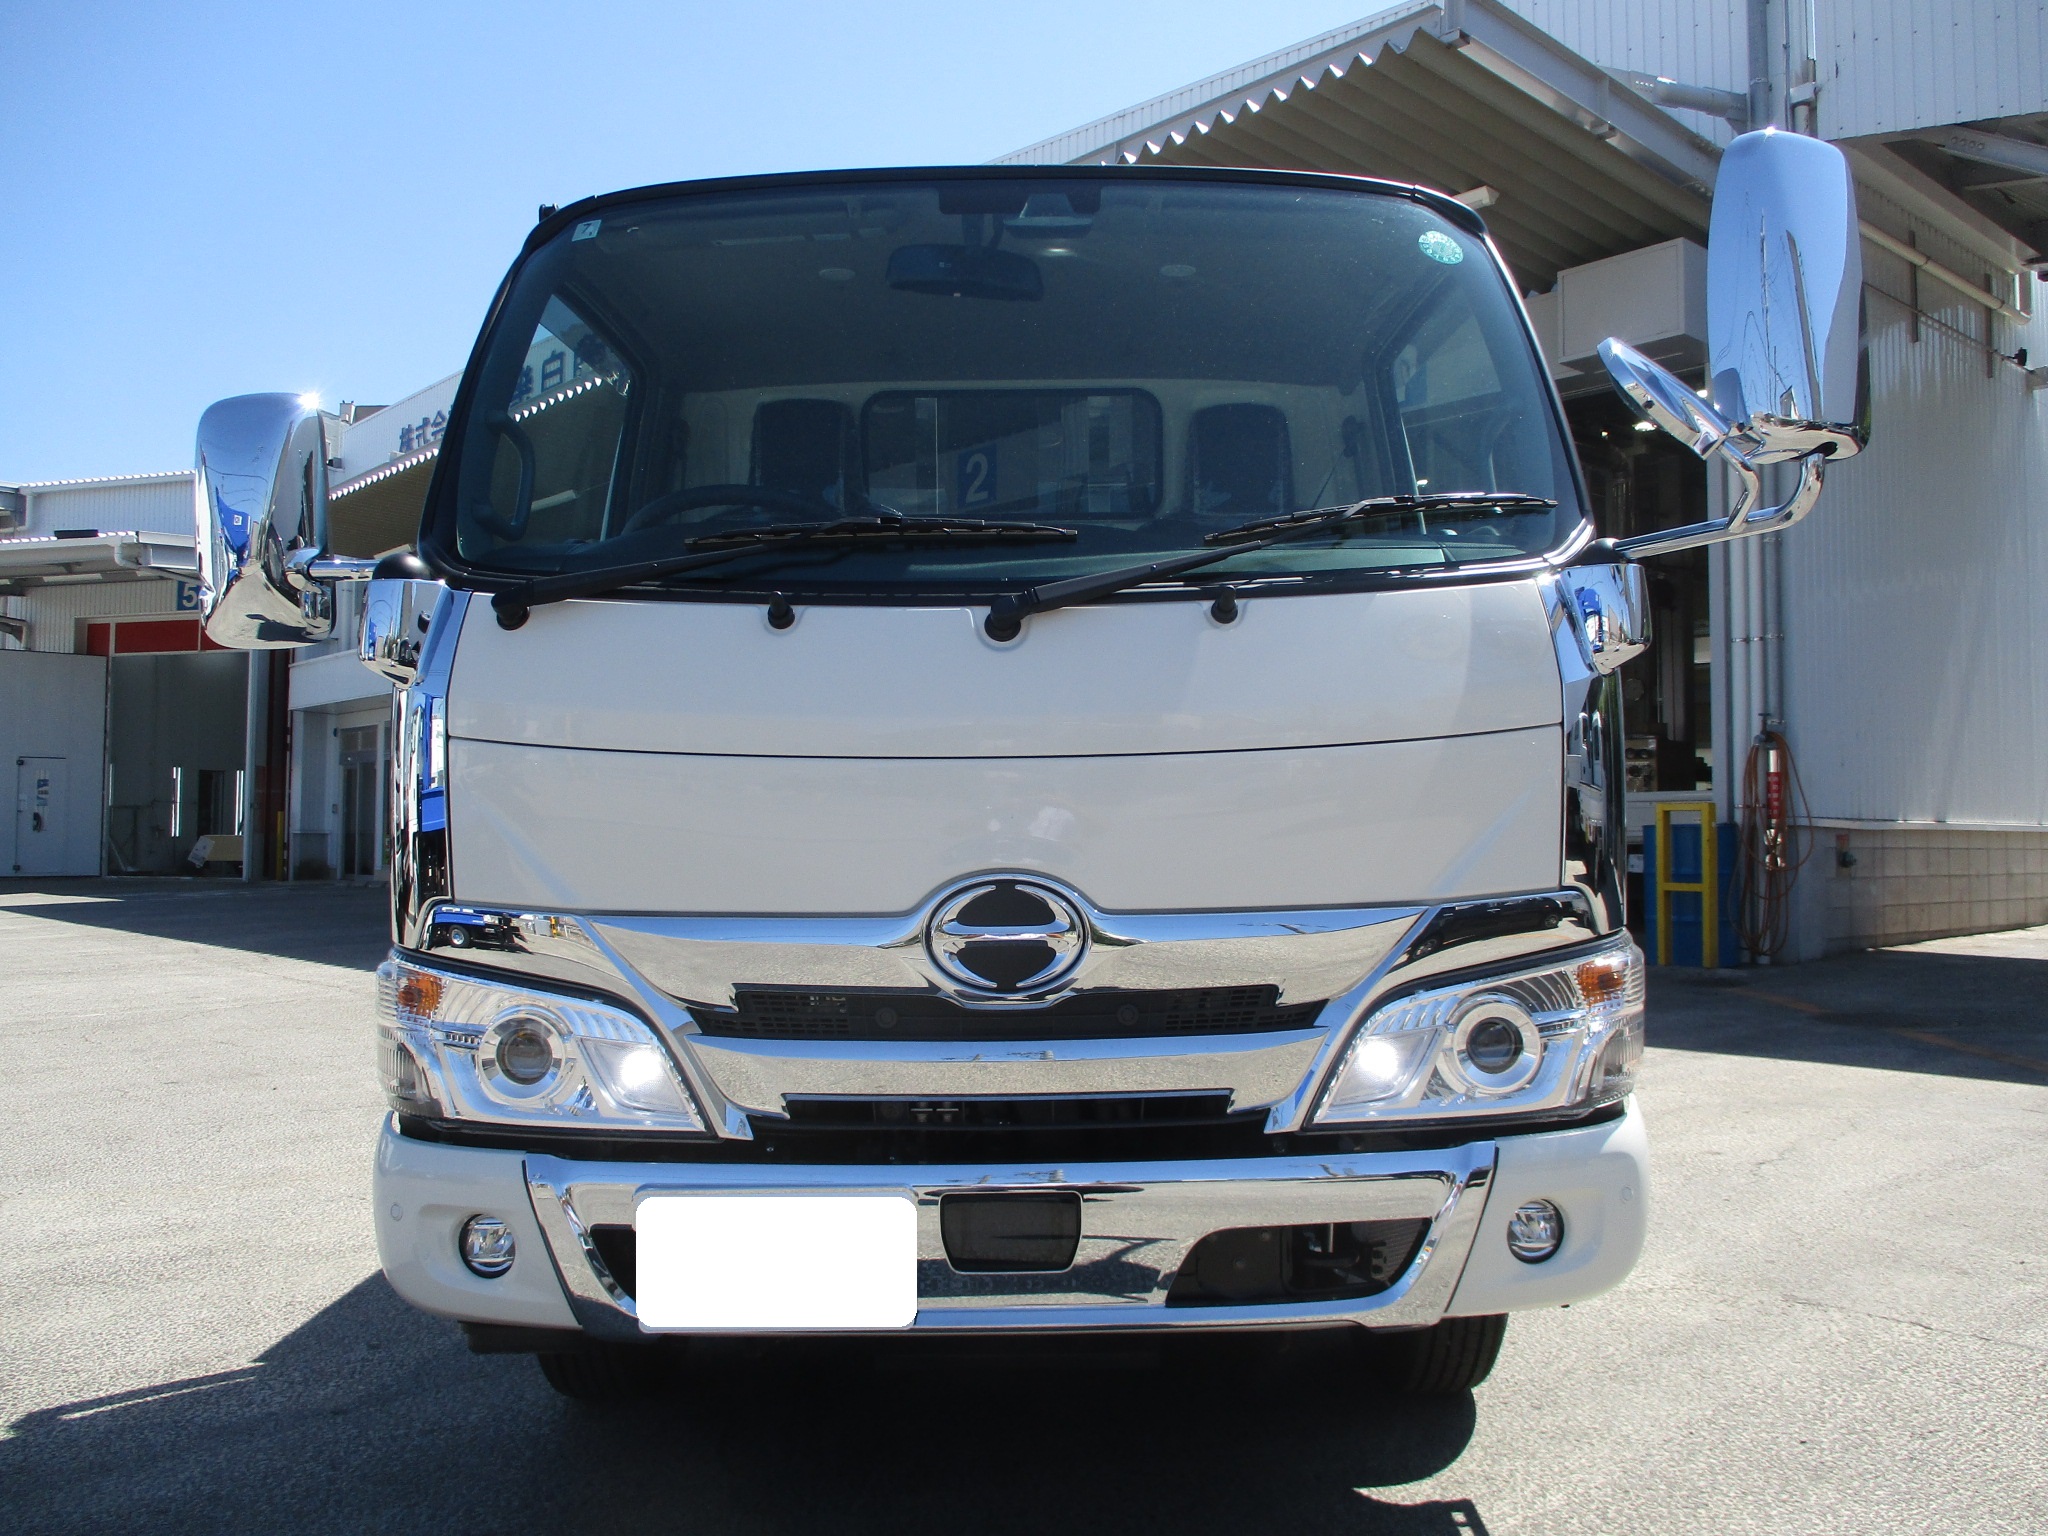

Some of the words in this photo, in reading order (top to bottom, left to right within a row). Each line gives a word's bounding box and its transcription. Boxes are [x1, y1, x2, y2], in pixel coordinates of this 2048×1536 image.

[399, 406, 456, 453] 株式会
[966, 453, 989, 504] 2
[182, 583, 198, 607] 5
